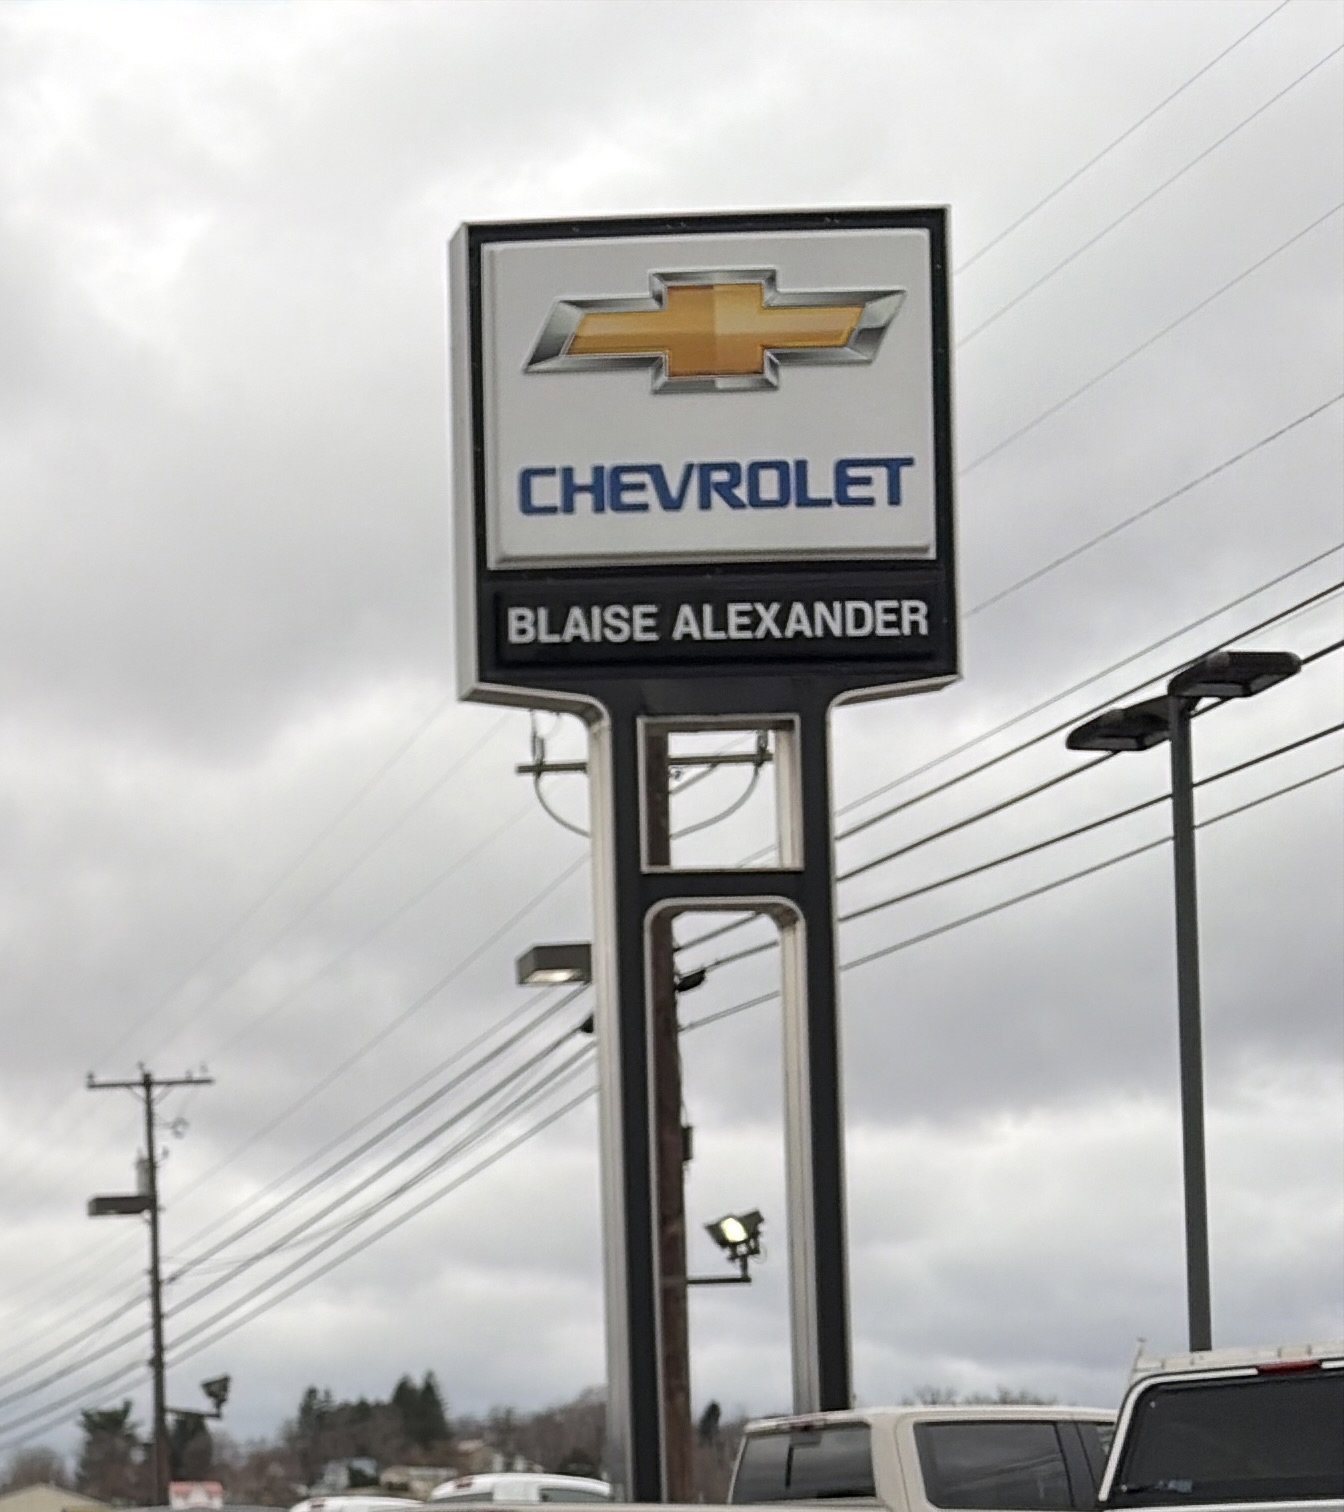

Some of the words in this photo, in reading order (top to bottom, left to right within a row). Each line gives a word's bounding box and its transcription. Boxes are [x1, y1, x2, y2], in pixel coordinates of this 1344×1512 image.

[519, 457, 914, 515] CHEVROLET
[507, 604, 659, 643] BLAISE
[672, 600, 929, 641] ALEXANDER
